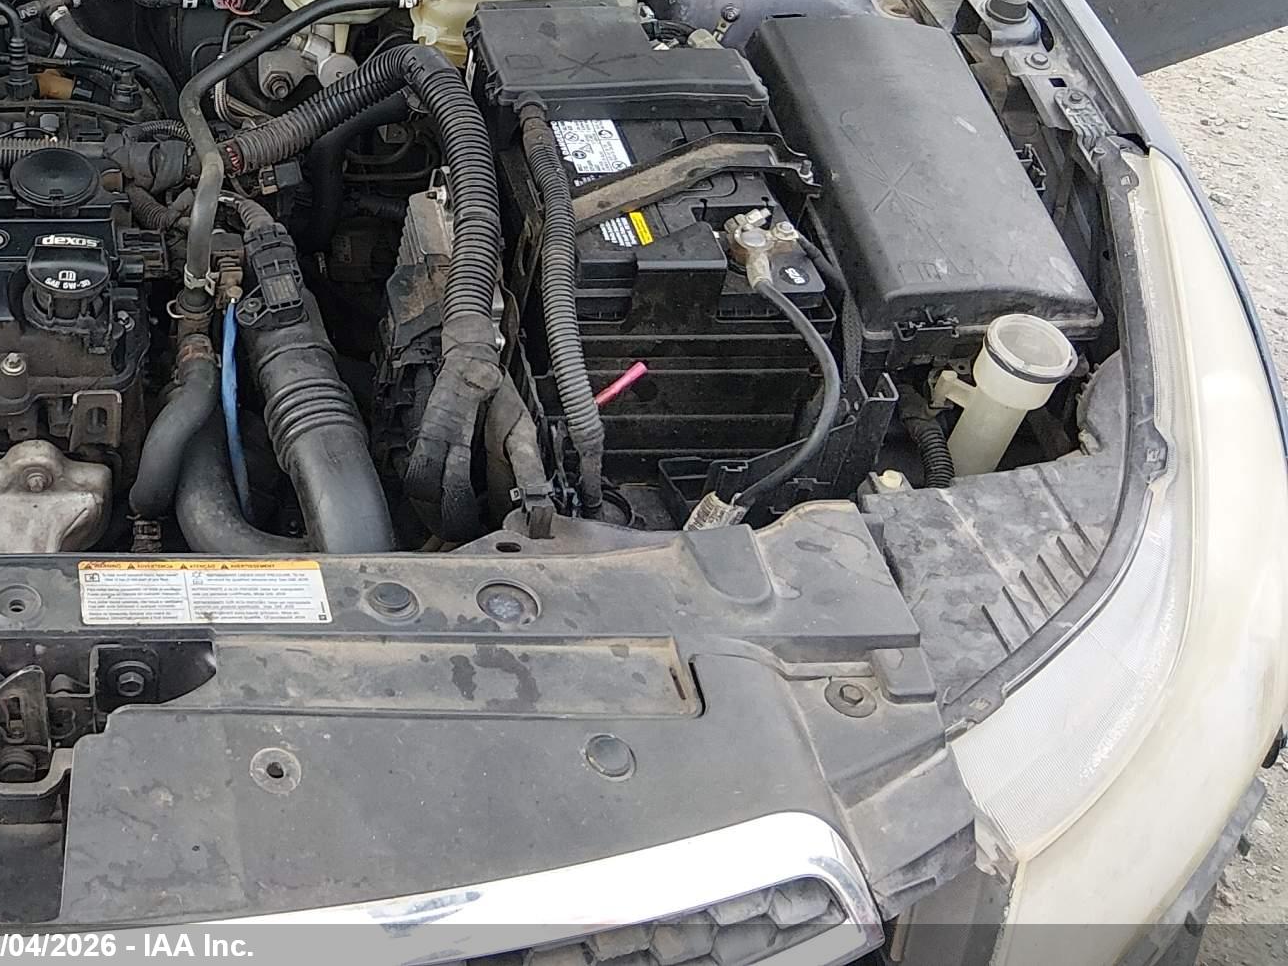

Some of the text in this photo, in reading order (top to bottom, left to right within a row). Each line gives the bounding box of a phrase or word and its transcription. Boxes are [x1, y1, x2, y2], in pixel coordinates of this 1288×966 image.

[42, 235, 100, 248] dexos
[44, 277, 91, 290] SAE 5W-30
